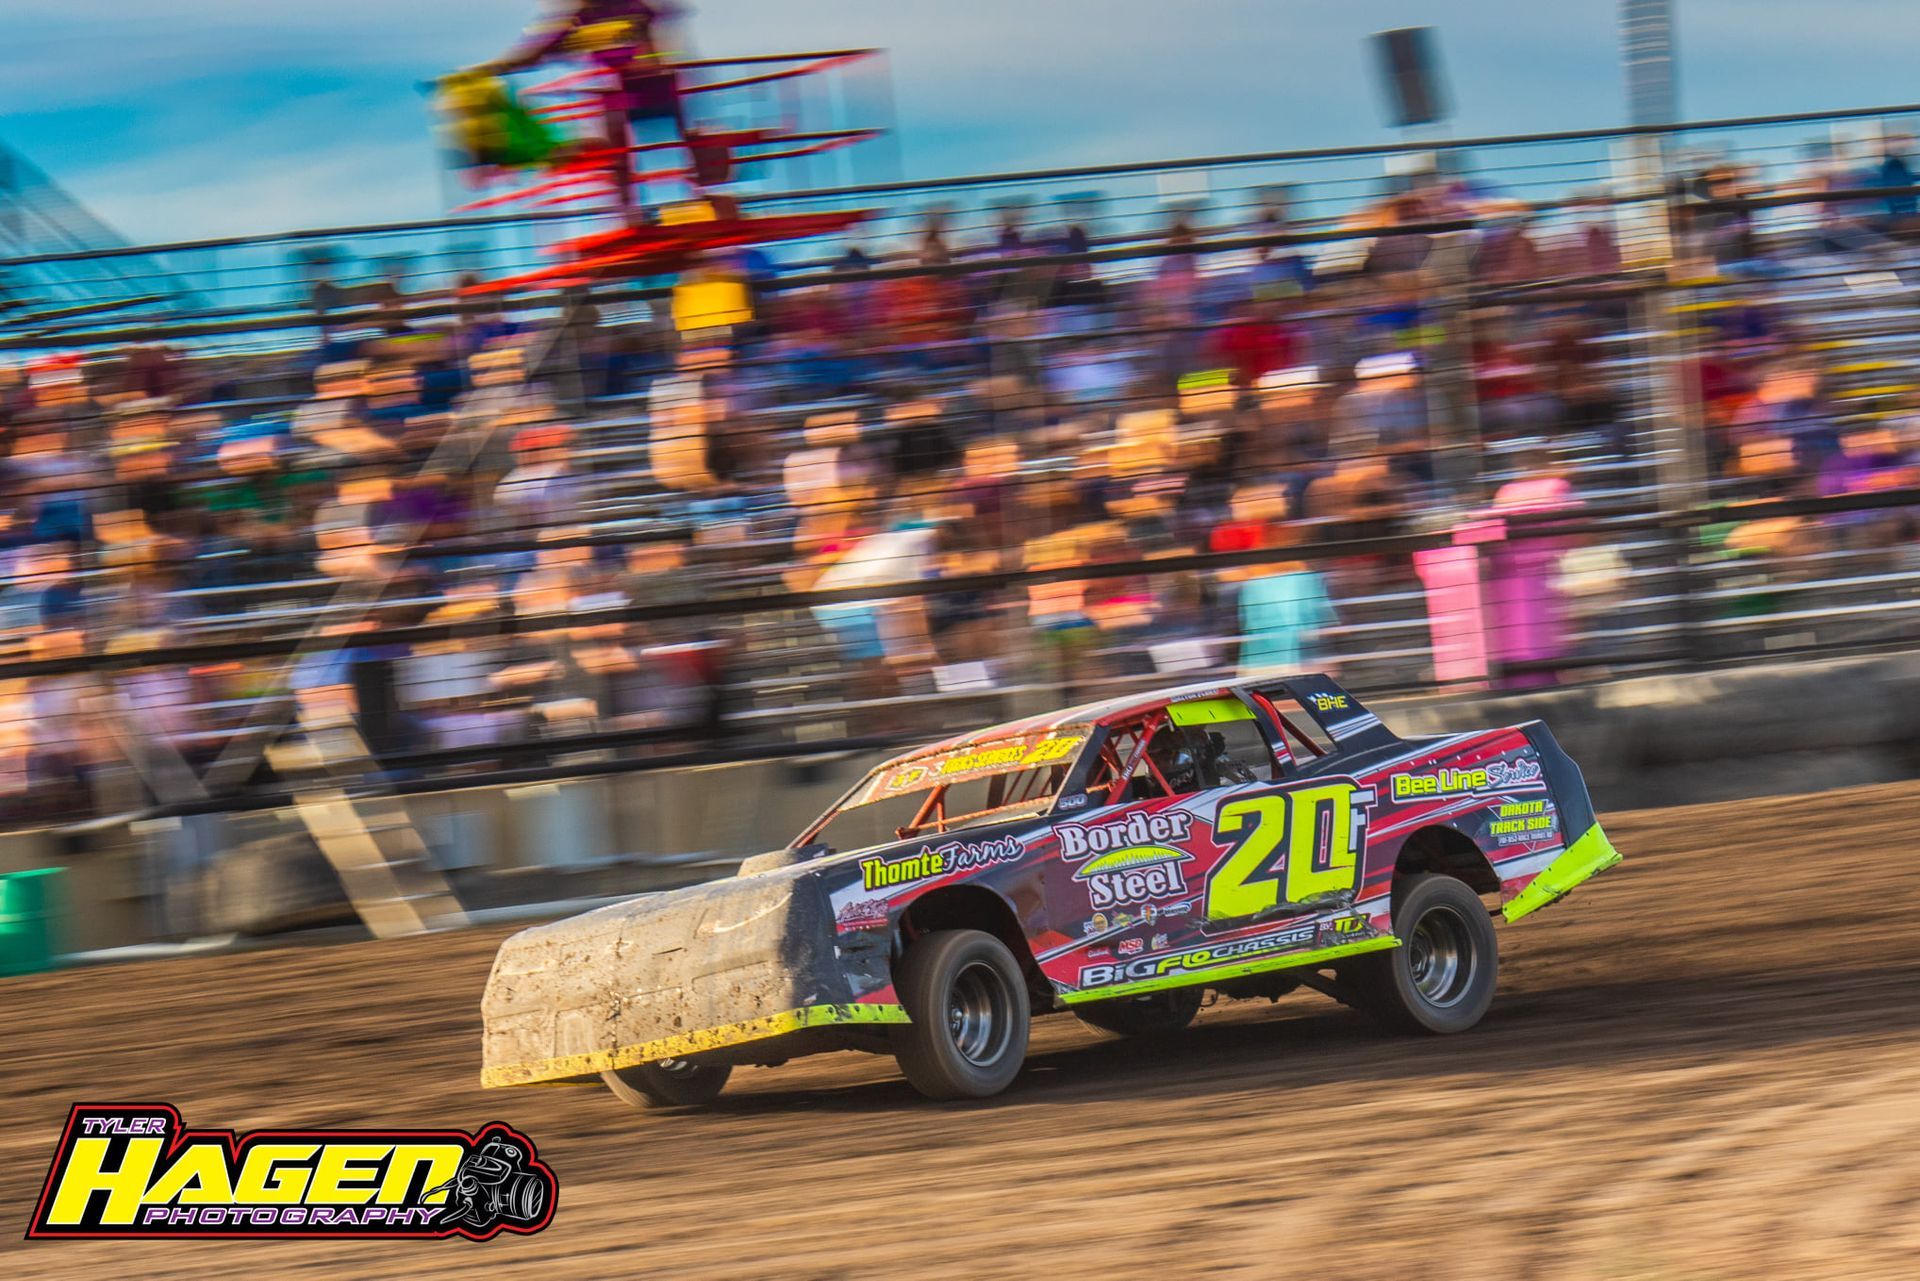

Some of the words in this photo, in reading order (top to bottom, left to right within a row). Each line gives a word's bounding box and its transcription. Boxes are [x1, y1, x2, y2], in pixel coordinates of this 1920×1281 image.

[1396, 775, 1437, 796] Bee
[1440, 770, 1487, 792] Line
[1490, 819, 1525, 835] TRACK
[1527, 816, 1552, 831] SIDE
[1501, 801, 1543, 817] DAKOTA
[1058, 813, 1188, 857] Border
[1208, 783, 1357, 921] 20
[862, 852, 943, 890] Thomte
[941, 837, 1021, 871] Farms
[1090, 861, 1182, 905] Steel
